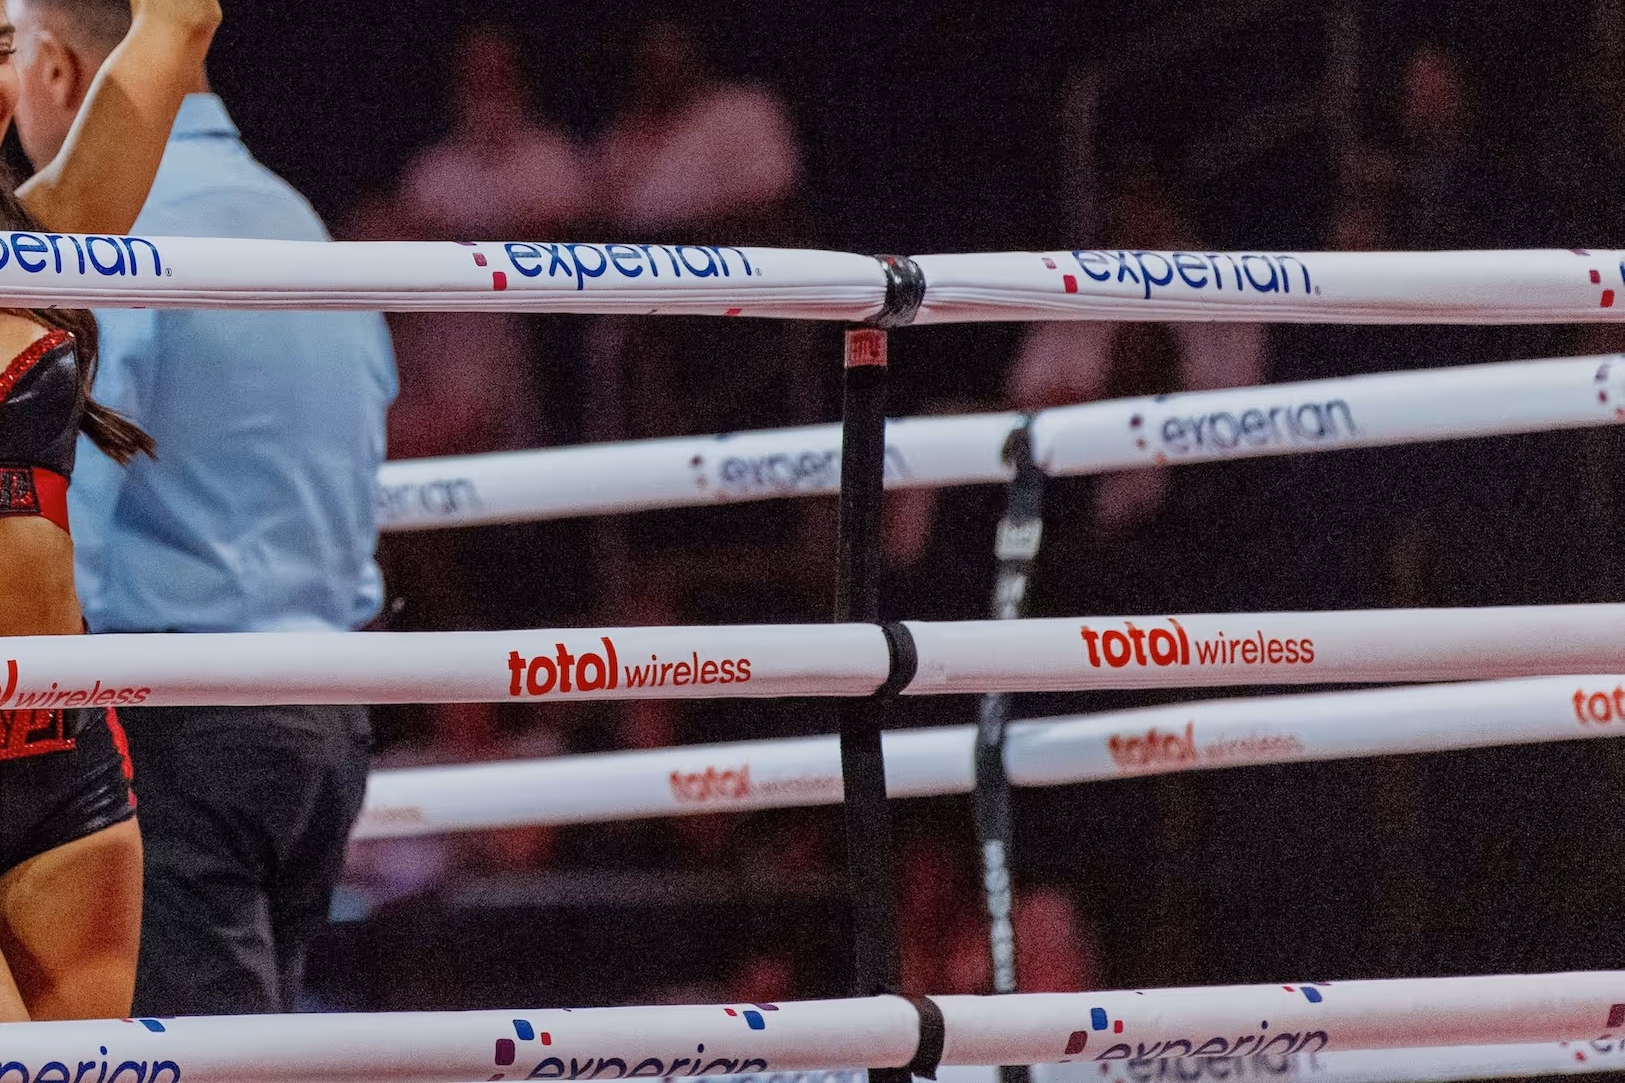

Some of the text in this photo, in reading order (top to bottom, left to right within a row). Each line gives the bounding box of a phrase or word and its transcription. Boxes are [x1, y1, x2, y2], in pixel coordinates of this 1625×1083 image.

[505, 242, 753, 291] experian
[1072, 250, 1312, 299] experian
[508, 637, 752, 695] total wireless
[1081, 618, 1315, 667] total wireless
[18, 680, 152, 707] wireless
[1572, 686, 1625, 724] tot
